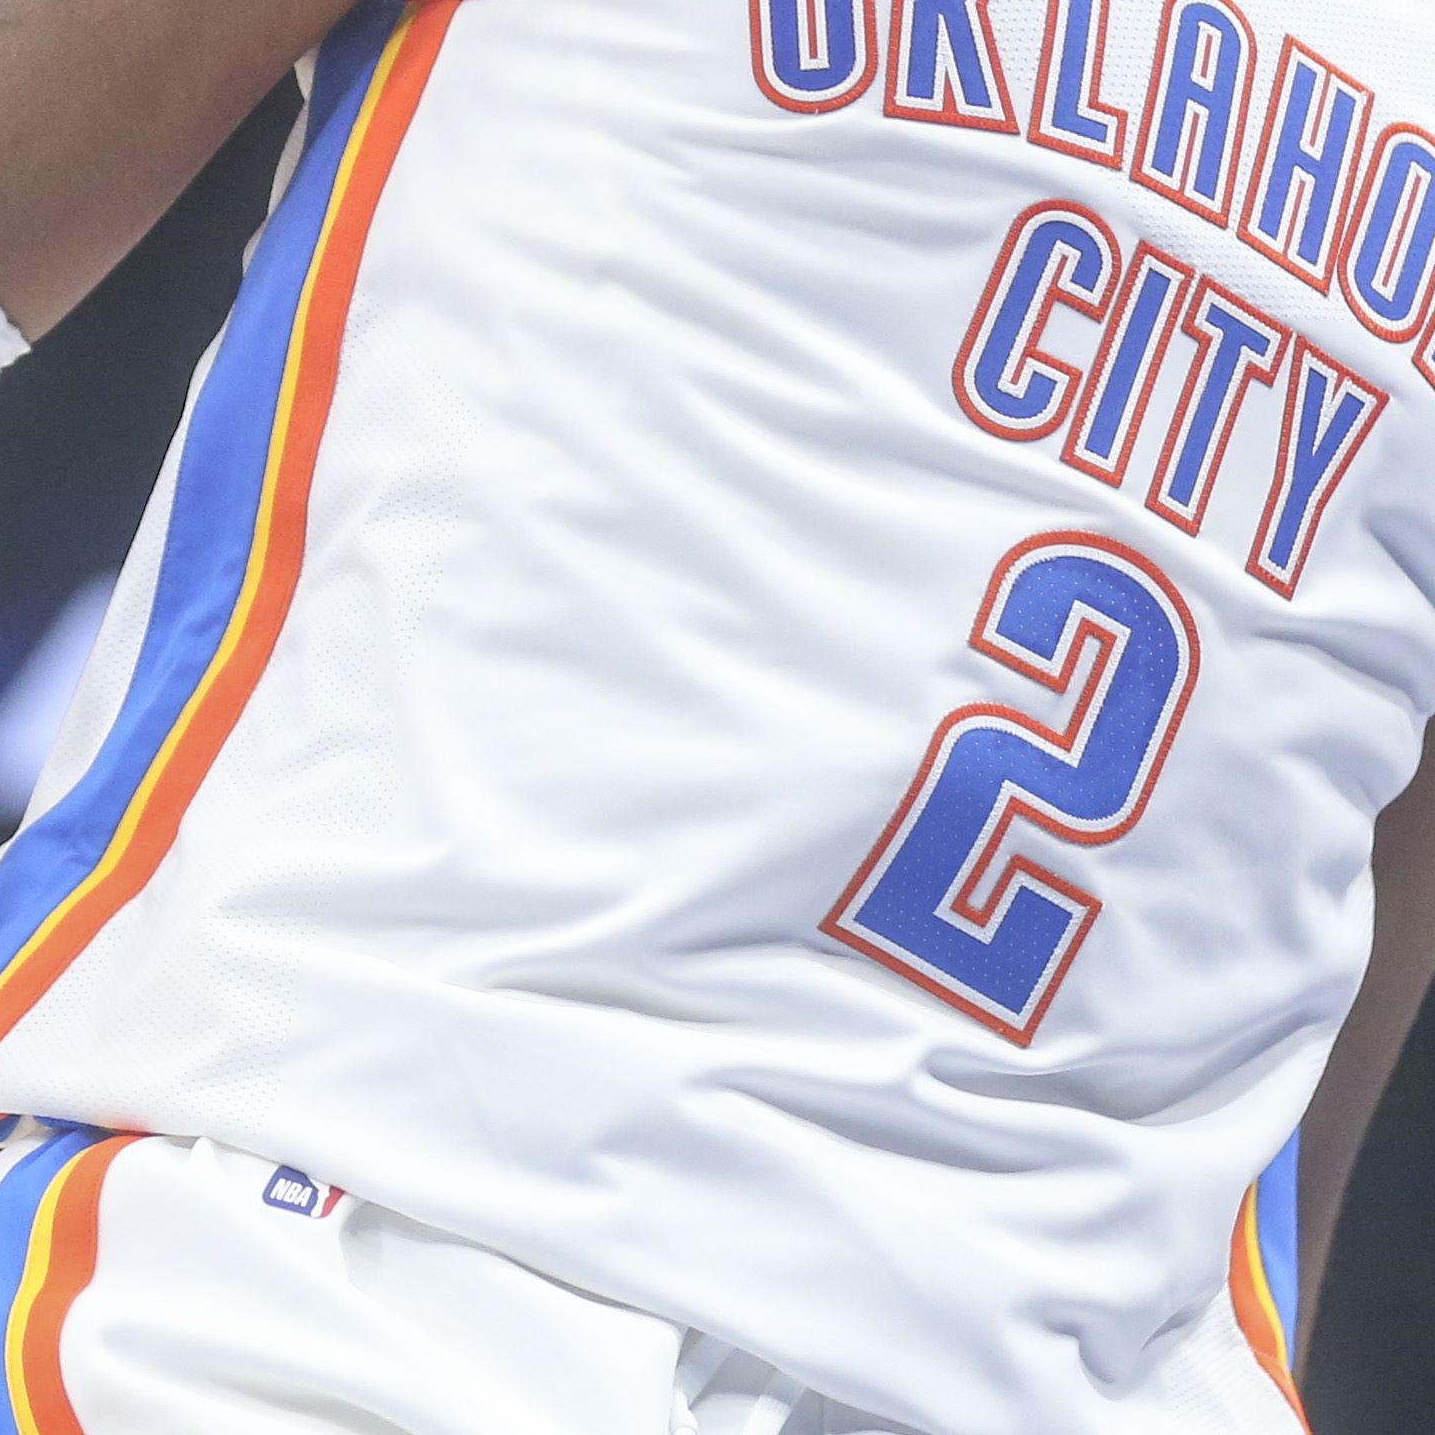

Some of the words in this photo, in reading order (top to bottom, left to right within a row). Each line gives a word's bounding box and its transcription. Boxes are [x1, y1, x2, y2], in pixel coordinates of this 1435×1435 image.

[951, 198, 1389, 600] CITY
[817, 529, 1201, 1048] 2
[270, 1178, 313, 1207] NBA
